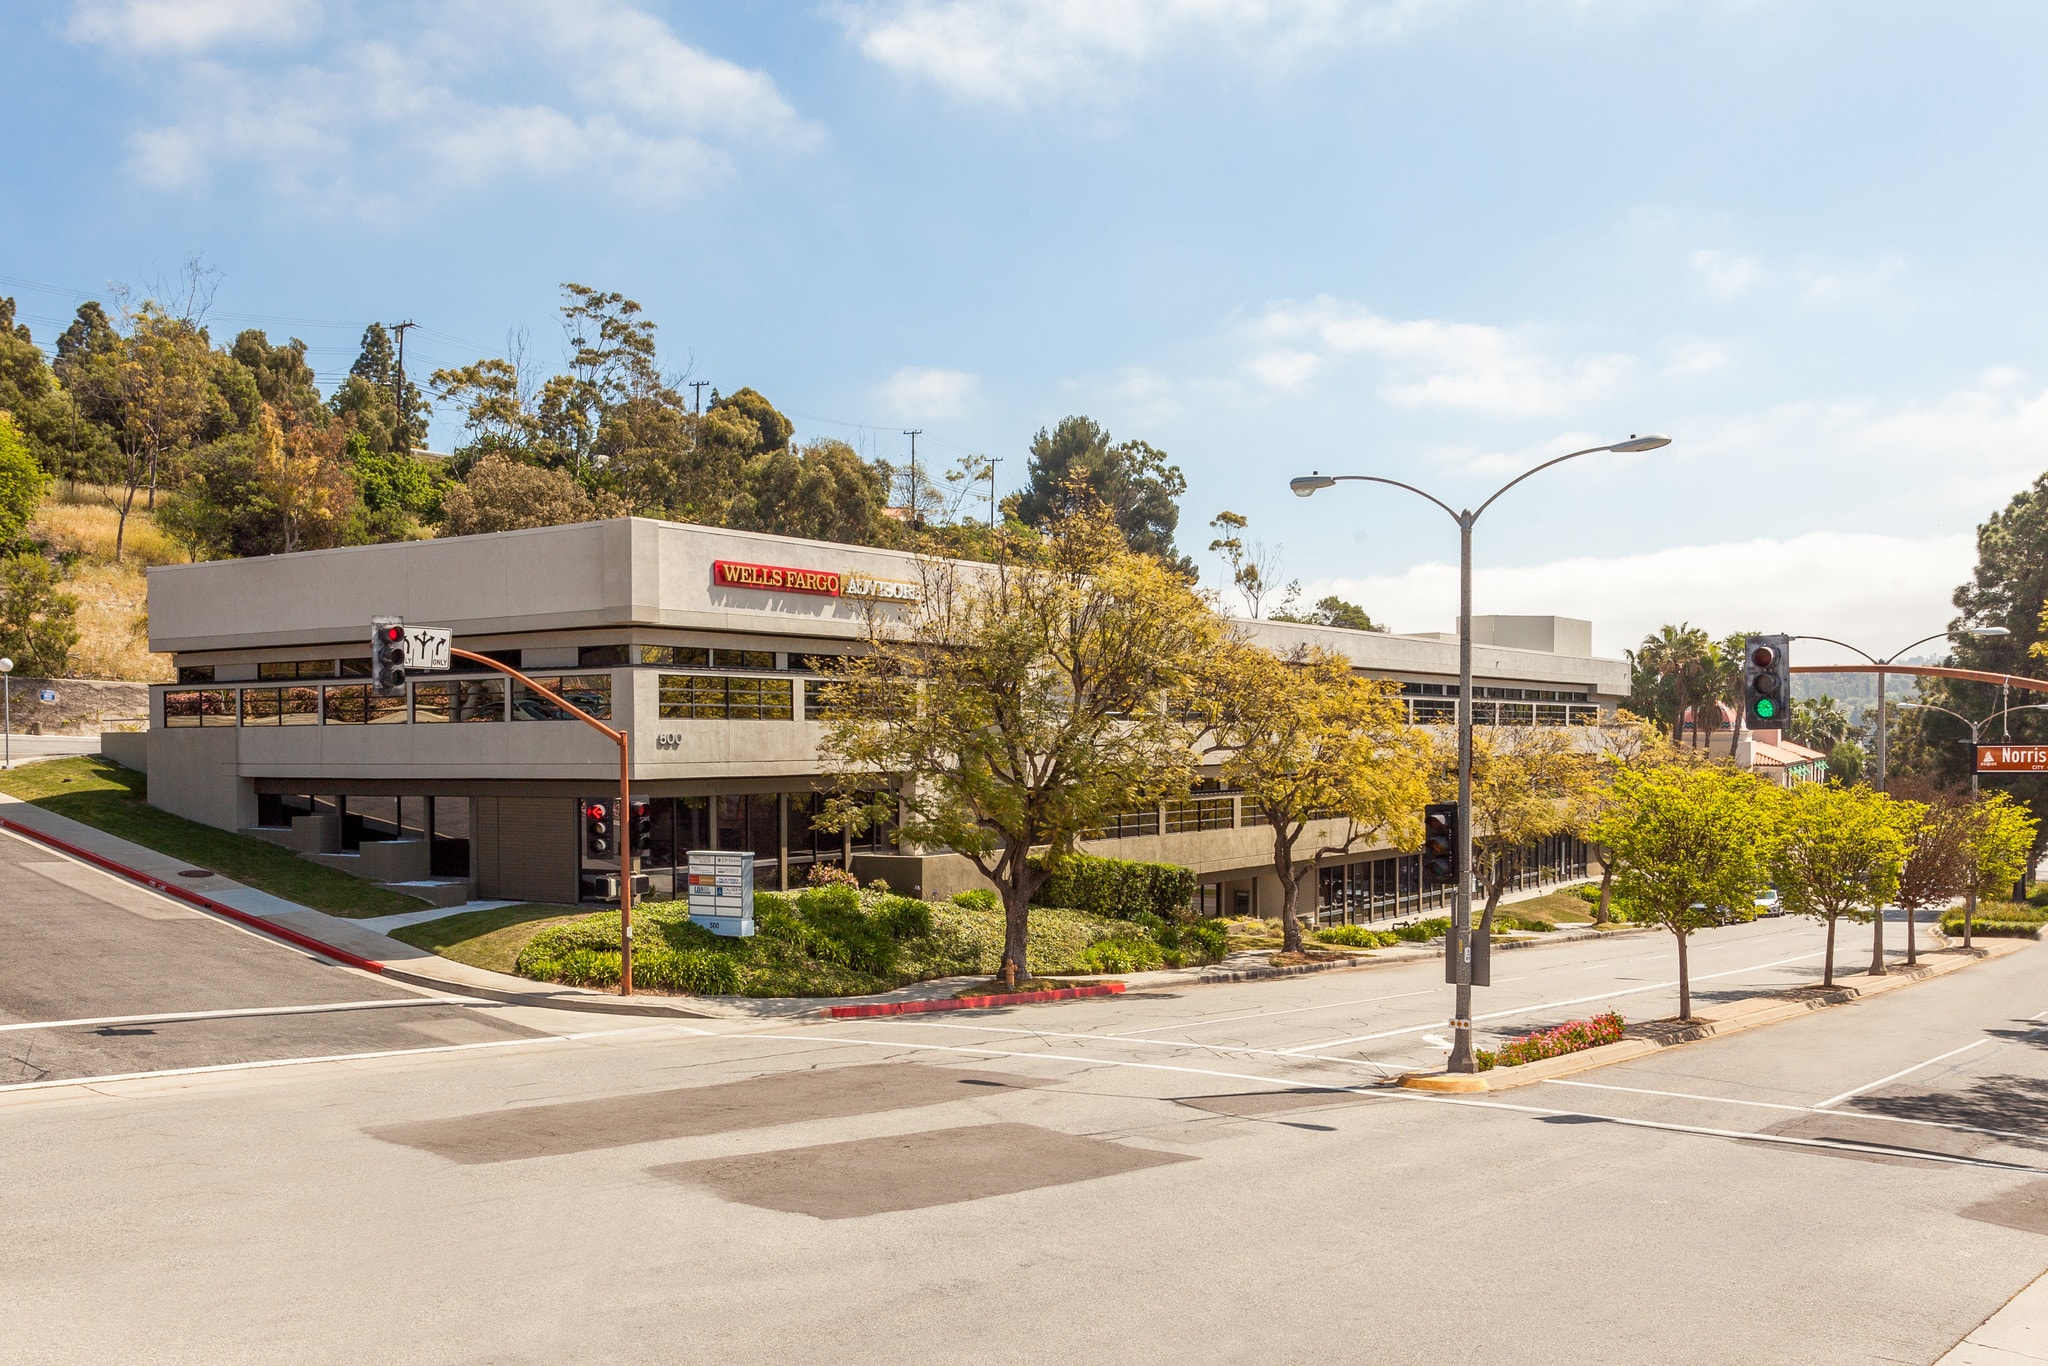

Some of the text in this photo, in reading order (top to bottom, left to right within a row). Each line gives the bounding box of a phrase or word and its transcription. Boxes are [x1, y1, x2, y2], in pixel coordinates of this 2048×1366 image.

[723, 564, 783, 587] WELLS
[785, 571, 839, 592] FARGO
[2001, 747, 2047, 763] Norris
[709, 921, 720, 929] 500
